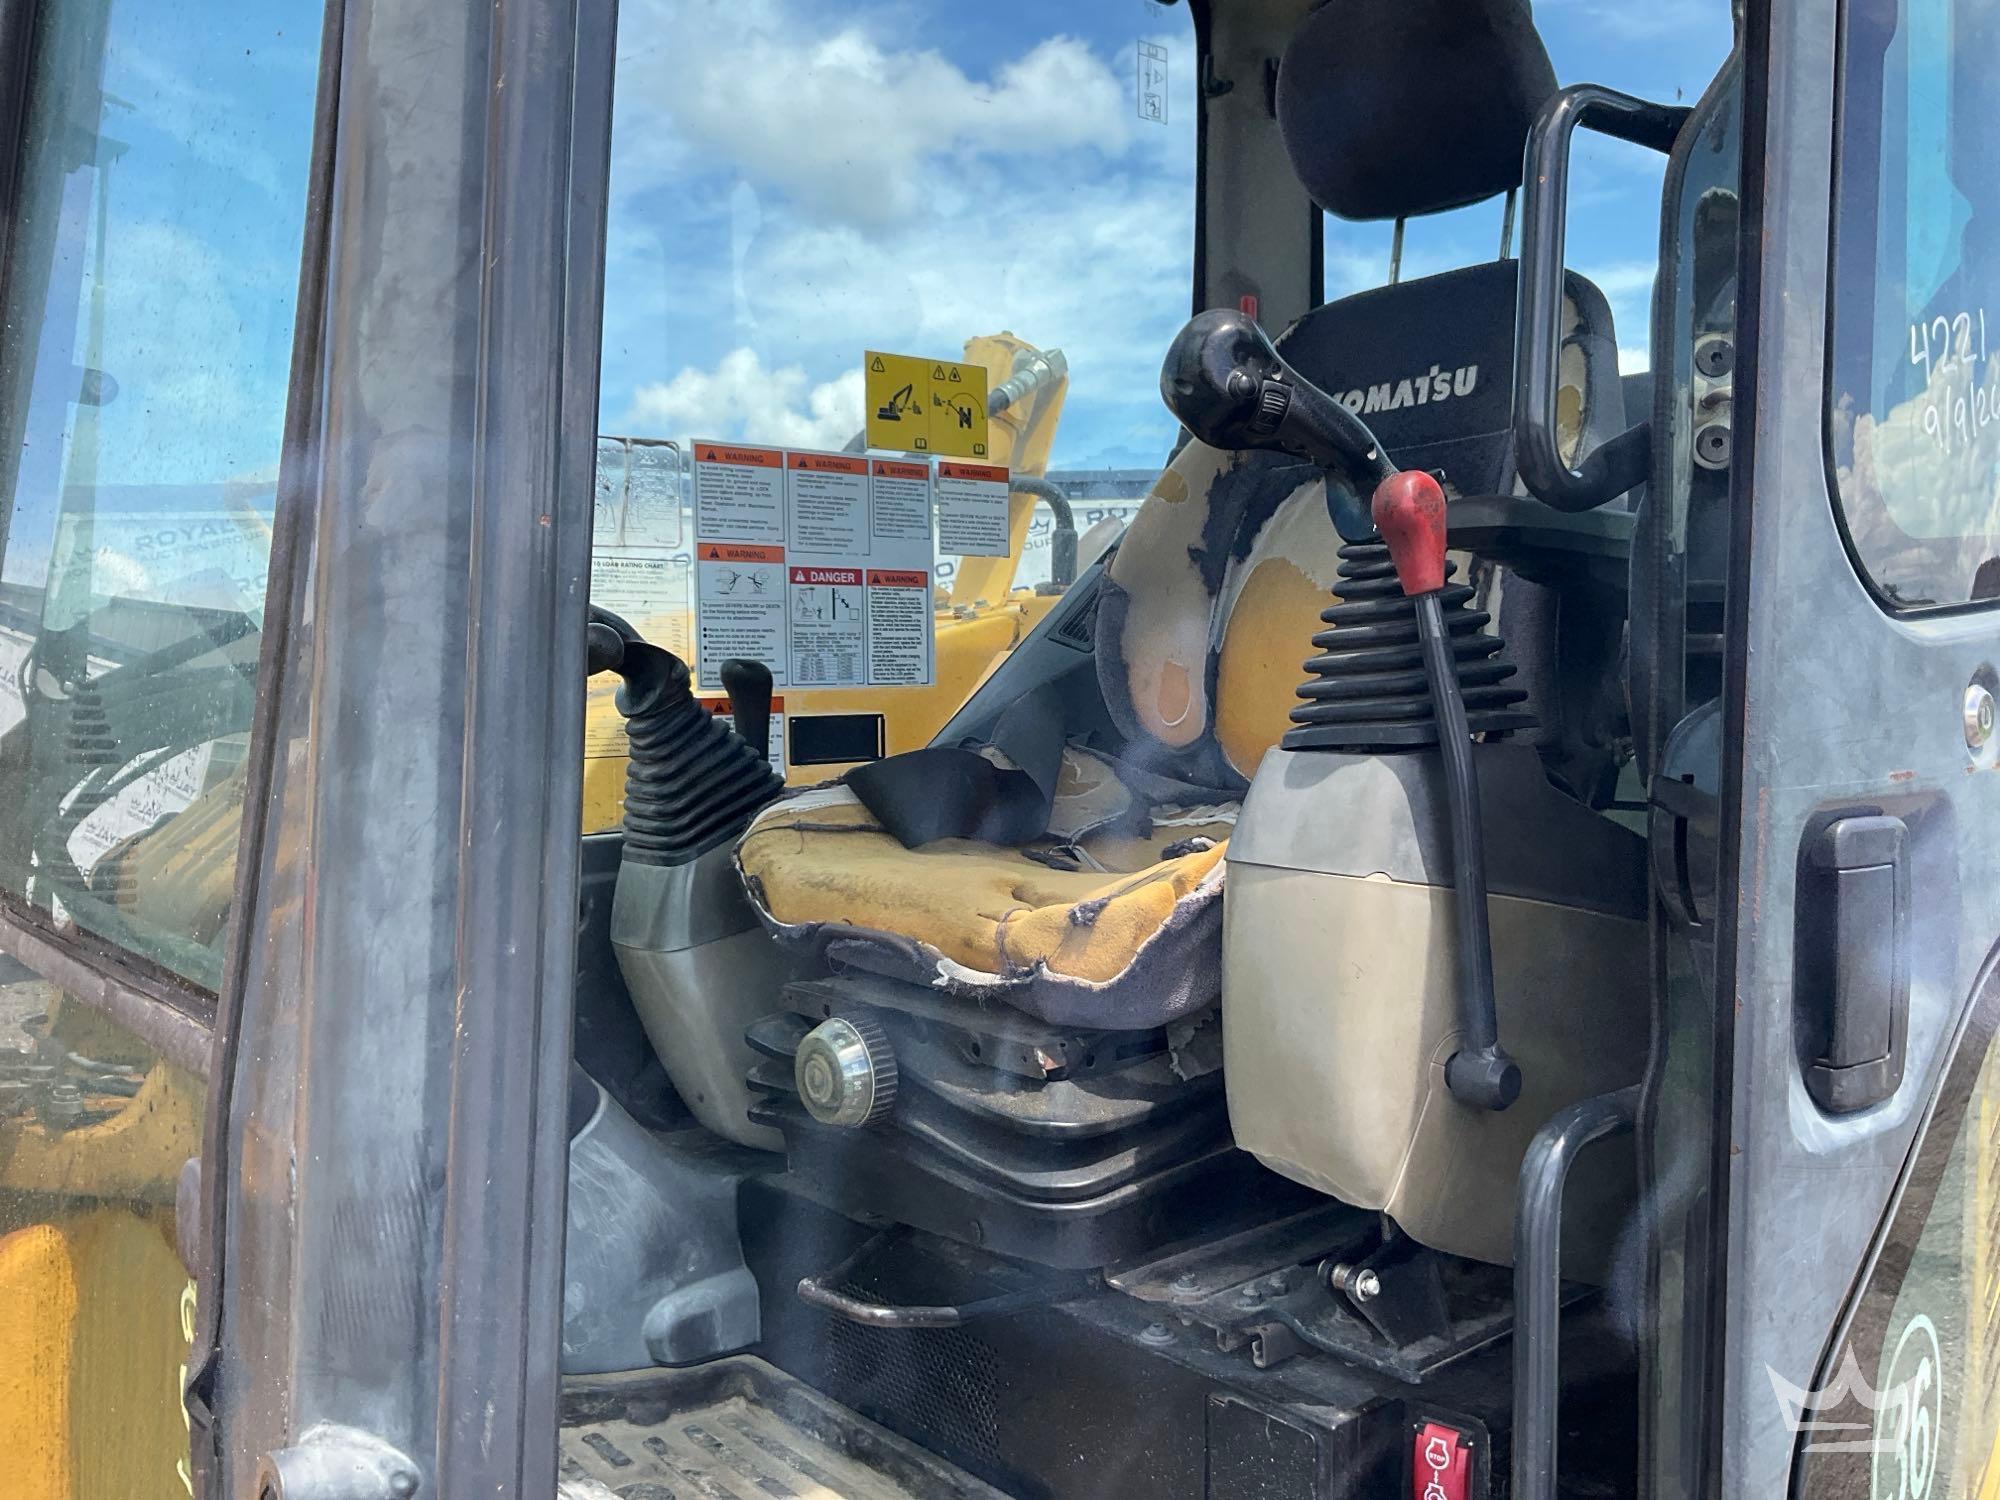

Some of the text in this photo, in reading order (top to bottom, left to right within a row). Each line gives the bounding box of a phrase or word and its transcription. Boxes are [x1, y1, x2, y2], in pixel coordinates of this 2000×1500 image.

[1911, 308, 1986, 385] 4221
[724, 451, 764, 463] WARNING
[815, 459, 852, 470] WARNING
[135, 519, 236, 551] ROYAL
[726, 549, 766, 560] WARNING
[810, 571, 856, 583] DANGER
[884, 575, 919, 584] WARNING
[1429, 1451, 1446, 1463] STOP
